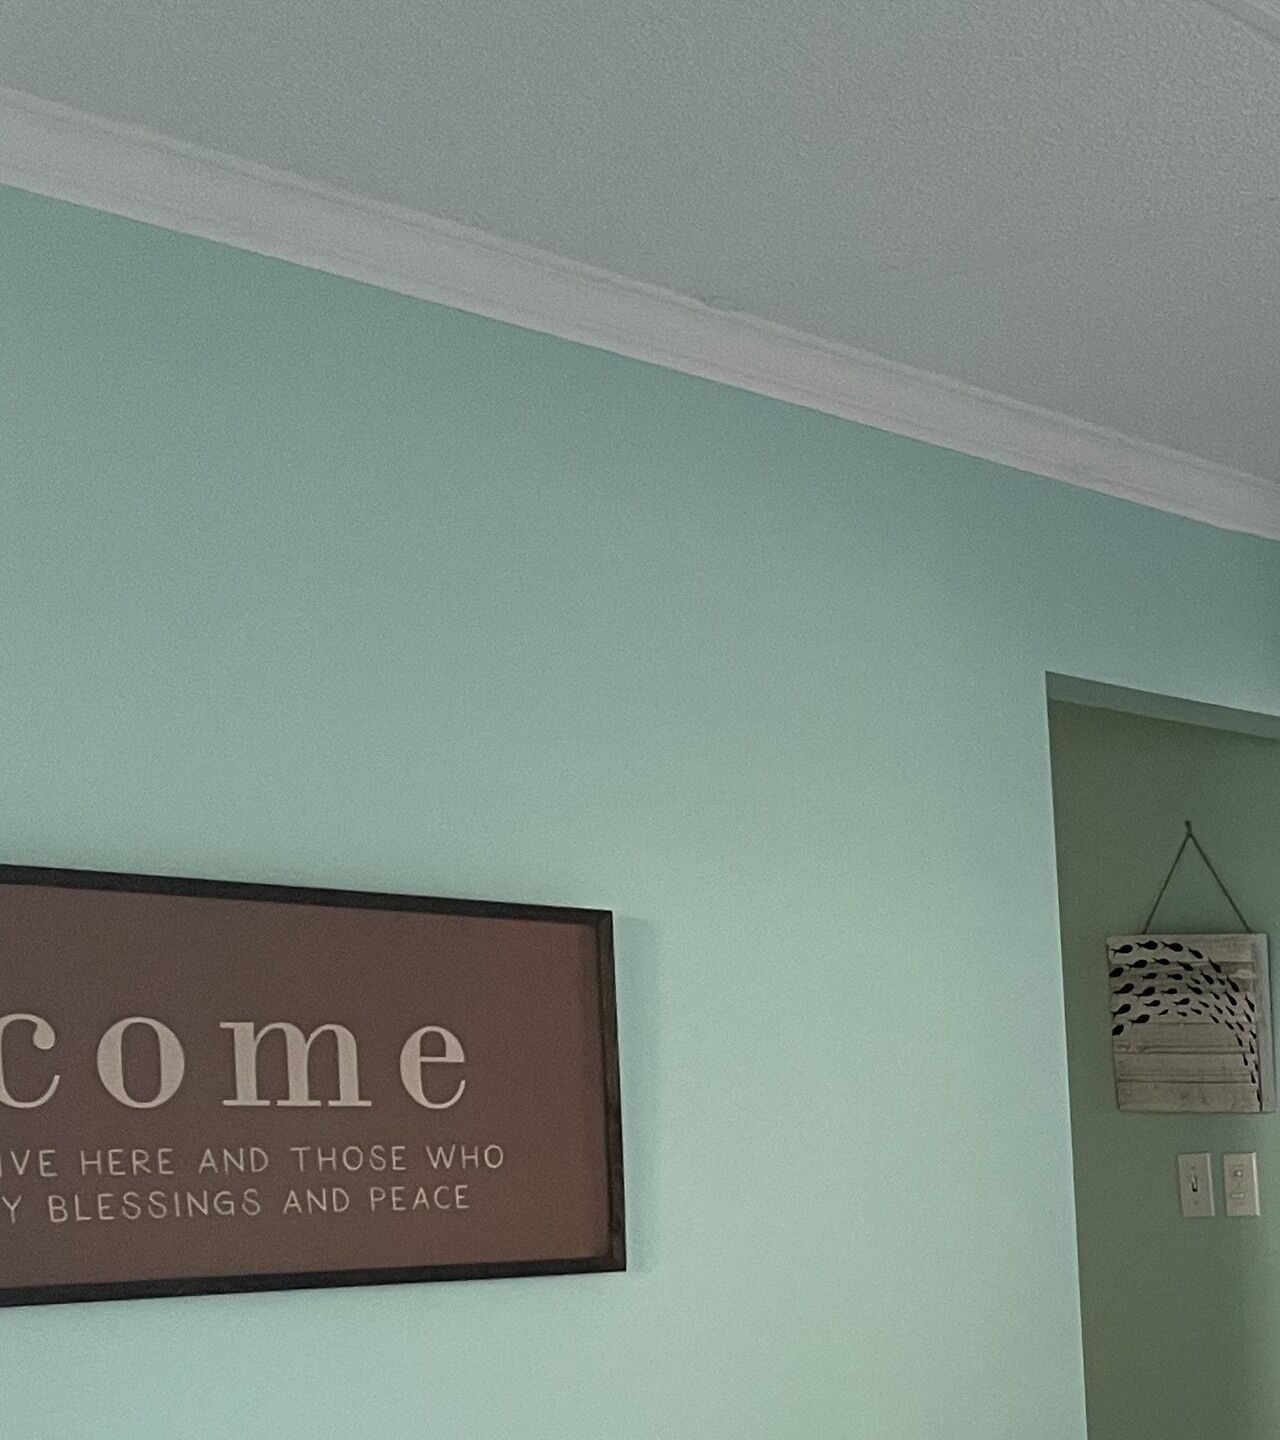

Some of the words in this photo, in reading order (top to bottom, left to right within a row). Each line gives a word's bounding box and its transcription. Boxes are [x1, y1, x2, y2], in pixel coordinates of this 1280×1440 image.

[80, 1148, 175, 1176] HERE
[198, 1147, 269, 1175] AND
[291, 1145, 406, 1172] THOSE
[427, 1144, 505, 1170] WHO
[48, 1188, 262, 1224] BLESSINGS
[282, 1187, 350, 1214] AND
[370, 1184, 470, 1212] PEACE
